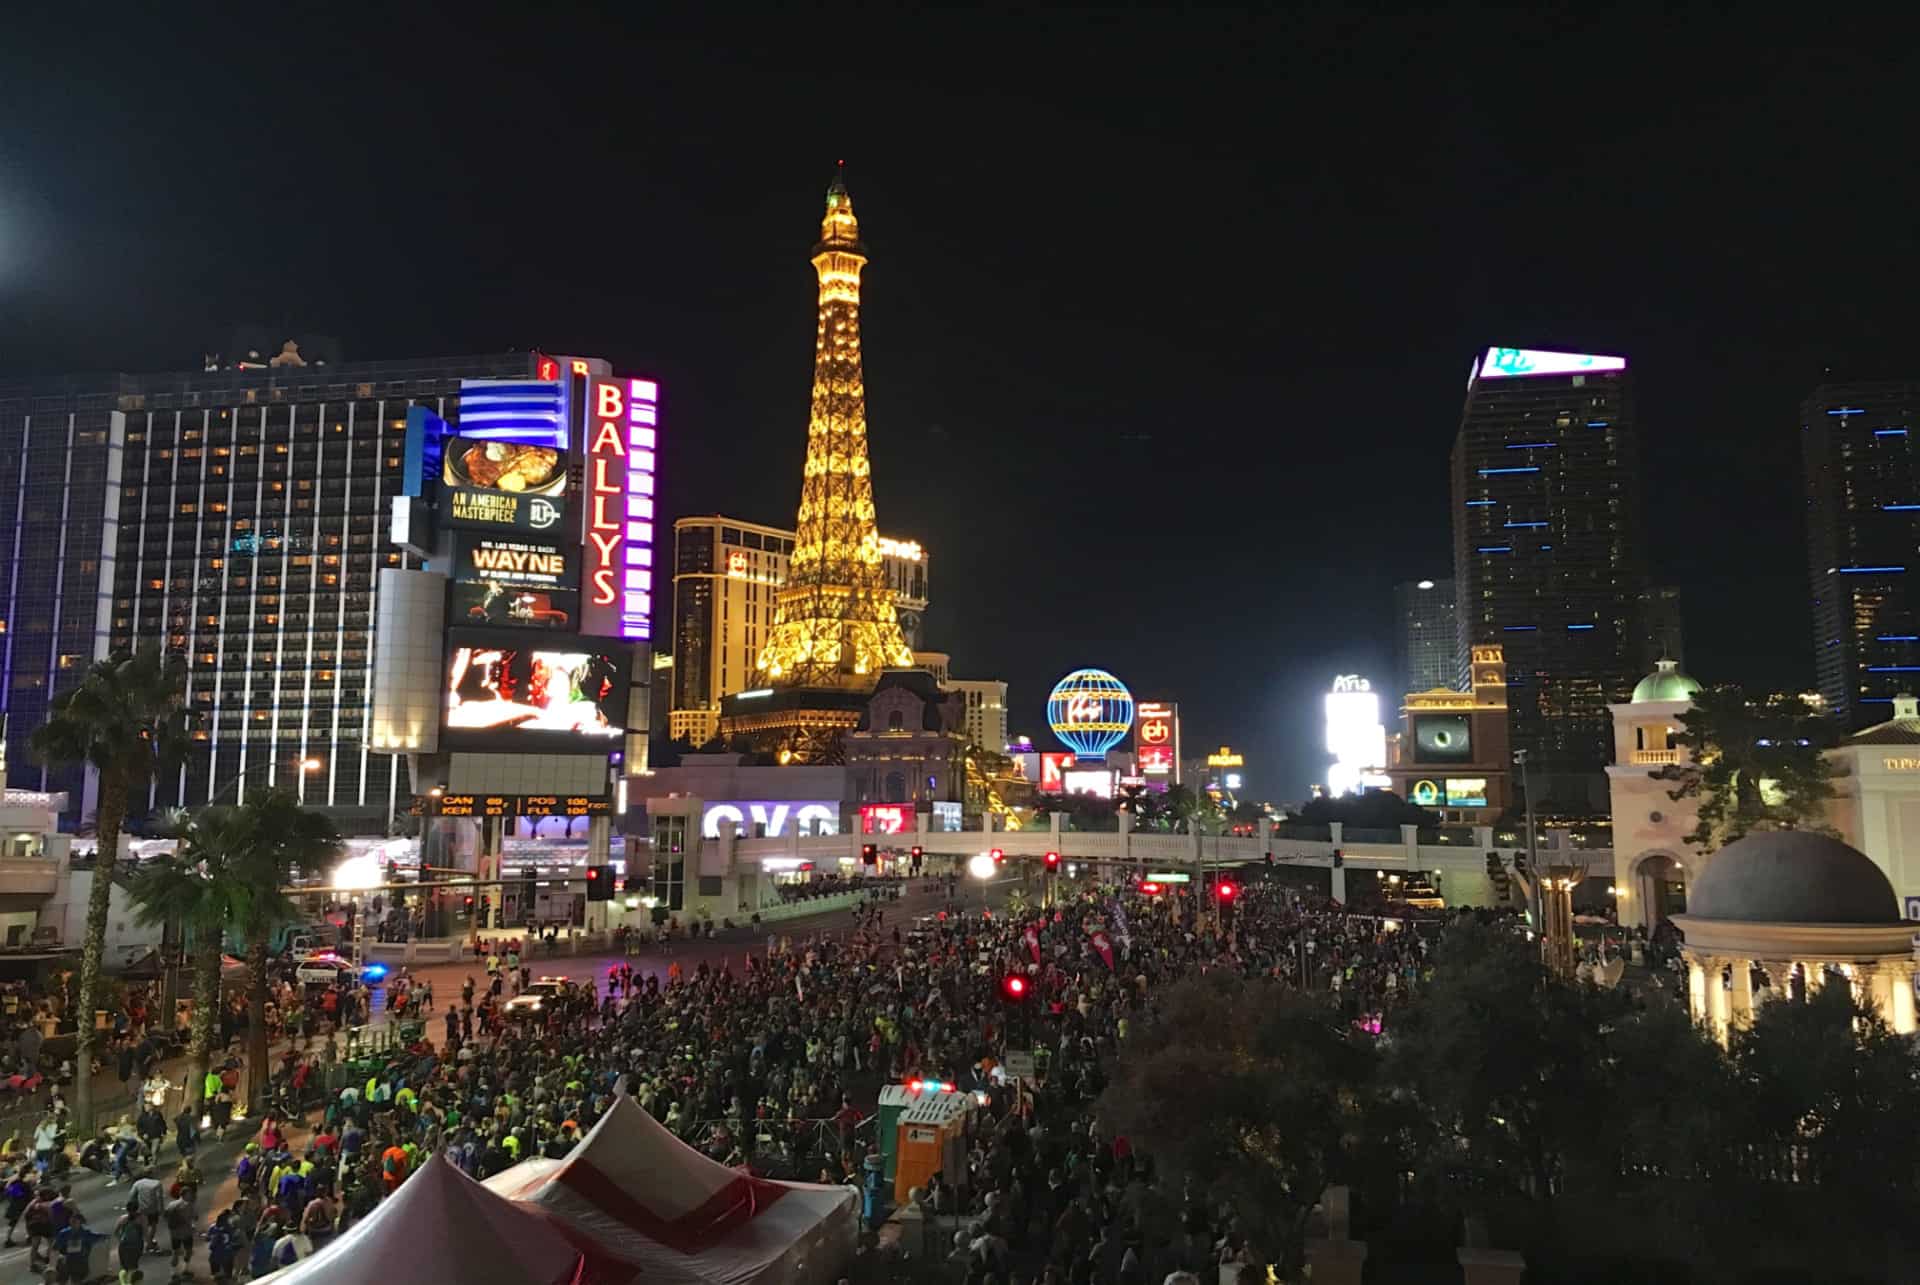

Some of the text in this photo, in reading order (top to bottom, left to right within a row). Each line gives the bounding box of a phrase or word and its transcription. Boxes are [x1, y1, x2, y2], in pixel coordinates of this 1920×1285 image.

[453, 492, 517, 510] AN AMERICAN
[590, 384, 625, 604] BALLYS
[453, 504, 515, 523] MASTERPIECE
[472, 549, 565, 574] WAYNE
[441, 806, 473, 815] KEN
[527, 806, 553, 815] FUL
